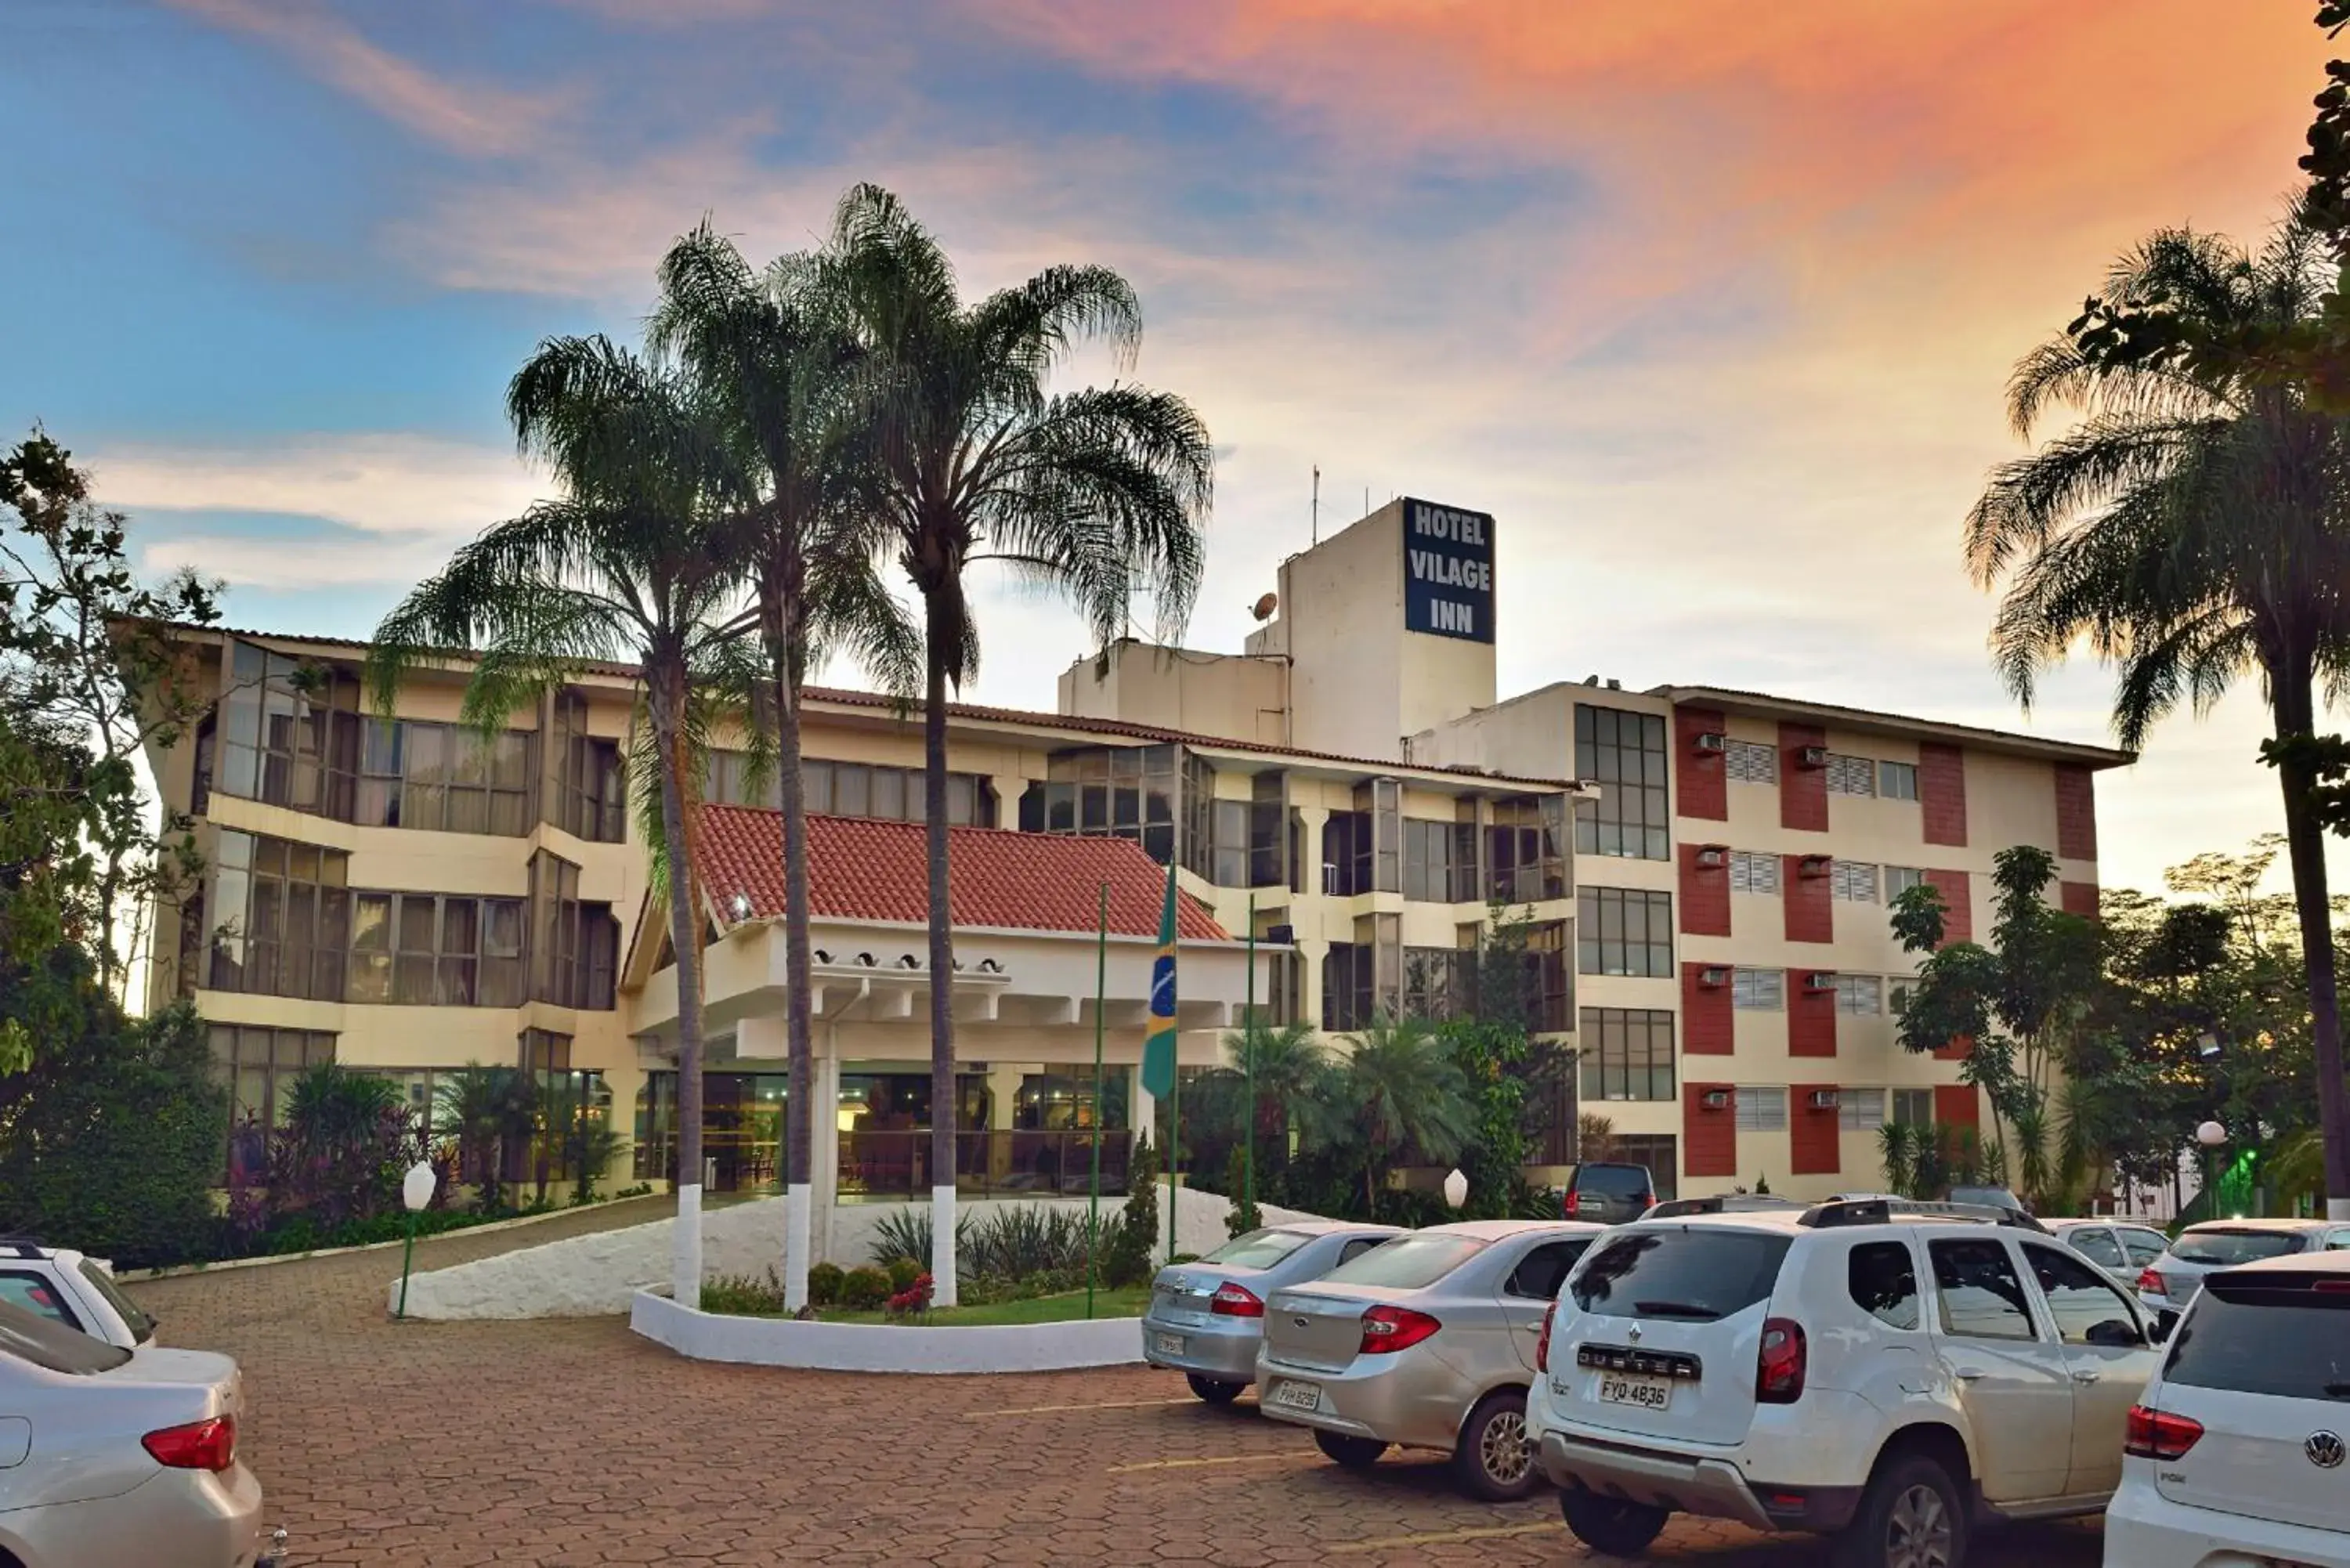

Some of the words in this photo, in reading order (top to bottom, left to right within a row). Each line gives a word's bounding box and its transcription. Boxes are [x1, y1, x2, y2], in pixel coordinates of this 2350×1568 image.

[1415, 504, 1485, 546] HOTEL
[1410, 549, 1491, 591] VILAGE
[1430, 598, 1473, 634] INN
